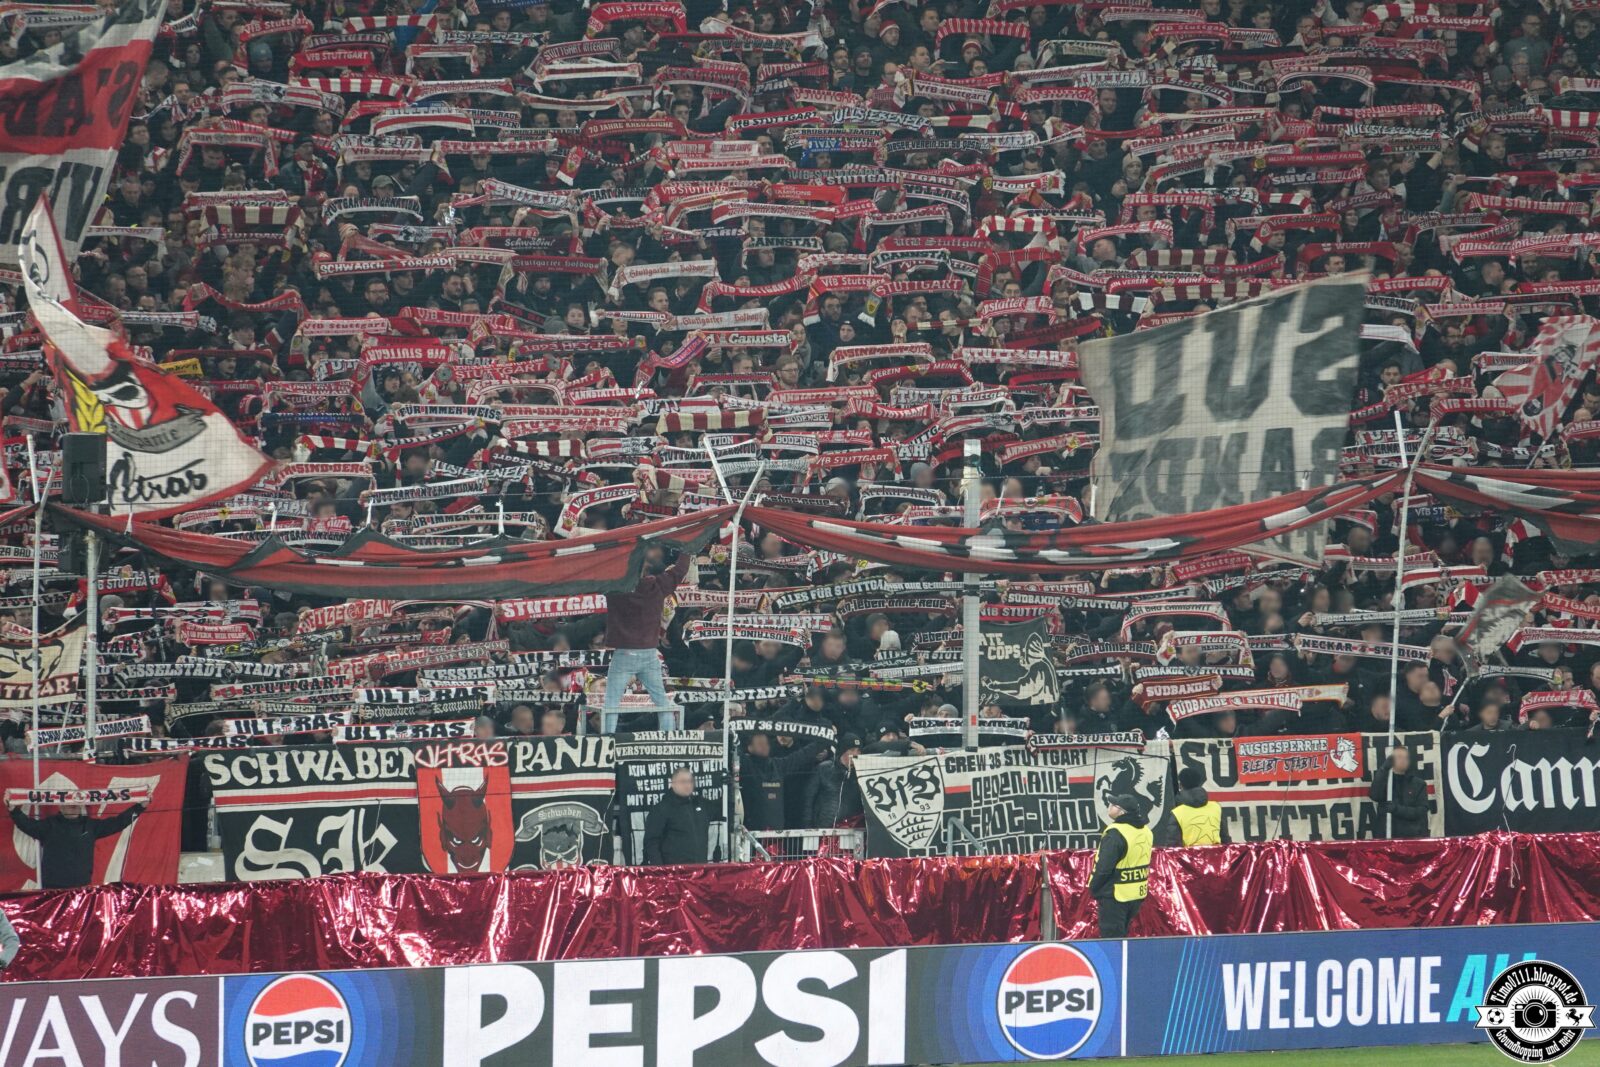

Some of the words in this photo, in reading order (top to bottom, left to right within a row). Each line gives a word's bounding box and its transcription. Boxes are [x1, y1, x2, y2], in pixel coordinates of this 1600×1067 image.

[604, 6, 624, 15] VfB
[626, 3, 686, 20] STUTTGART
[1432, 15, 1490, 27] Stuttgart
[306, 53, 321, 62] VfB
[322, 50, 369, 61] STUTTGART
[916, 83, 936, 94] VfB
[939, 87, 989, 101] Stuttgart
[750, 111, 817, 127] STUTTGART
[588, 126, 599, 135] 70
[601, 121, 623, 132] JAHRE
[822, 276, 841, 286] VfB
[876, 280, 961, 297] STUTTGART
[326, 320, 387, 331] Stuttgart
[872, 368, 901, 380] VEREIN
[933, 362, 960, 372] MEINE
[400, 405, 420, 419] FÜR
[424, 405, 463, 417] IMMER
[466, 405, 501, 418] WEISS
[785, 414, 830, 423] BODENSEE
[834, 453, 890, 465] STUTTGART
[572, 495, 590, 510] VfB
[1415, 507, 1431, 516] VfB
[430, 514, 468, 525] IMMER
[678, 592, 702, 601] VfB
[778, 592, 809, 608] ALLES
[811, 588, 833, 600] FÜR
[504, 594, 608, 618] STUTTGAR
[979, 632, 1004, 646] ATE
[1176, 637, 1198, 646] VfB
[1302, 639, 1354, 651] NECKAR
[987, 644, 1022, 660] COPS
[424, 661, 540, 681] KESSELSTADT
[242, 675, 347, 695] STUTTGART
[676, 686, 787, 703] KESSELSTADT
[364, 703, 416, 719] Schwaben
[432, 699, 481, 715] Kompanie
[759, 720, 773, 731] 36
[632, 730, 666, 741] EHRE
[667, 730, 704, 741] ALLEN
[616, 745, 689, 757] VERSTORBENEN
[689, 745, 724, 756] ULTRAS
[1238, 737, 1328, 757] AUSGESPERRTE
[414, 742, 509, 768] ULTRAS
[945, 754, 986, 773] CREW
[988, 753, 1001, 769] 36
[1004, 749, 1089, 767] STUTTGART
[648, 762, 667, 773] WEG
[689, 762, 700, 773] ZU
[1241, 757, 1278, 774] BLEIBT
[28, 788, 131, 804] ULTRAS
[626, 794, 644, 806] MIT
[538, 805, 582, 820] Schwaben
[919, 802, 931, 812] 93
[1222, 956, 1442, 1031] WELCOME
[442, 948, 907, 1067] PEPSI
[1004, 987, 1095, 1016] PEPSI
[0, 989, 200, 1067] AYS
[252, 1019, 345, 1047] PEPSI
